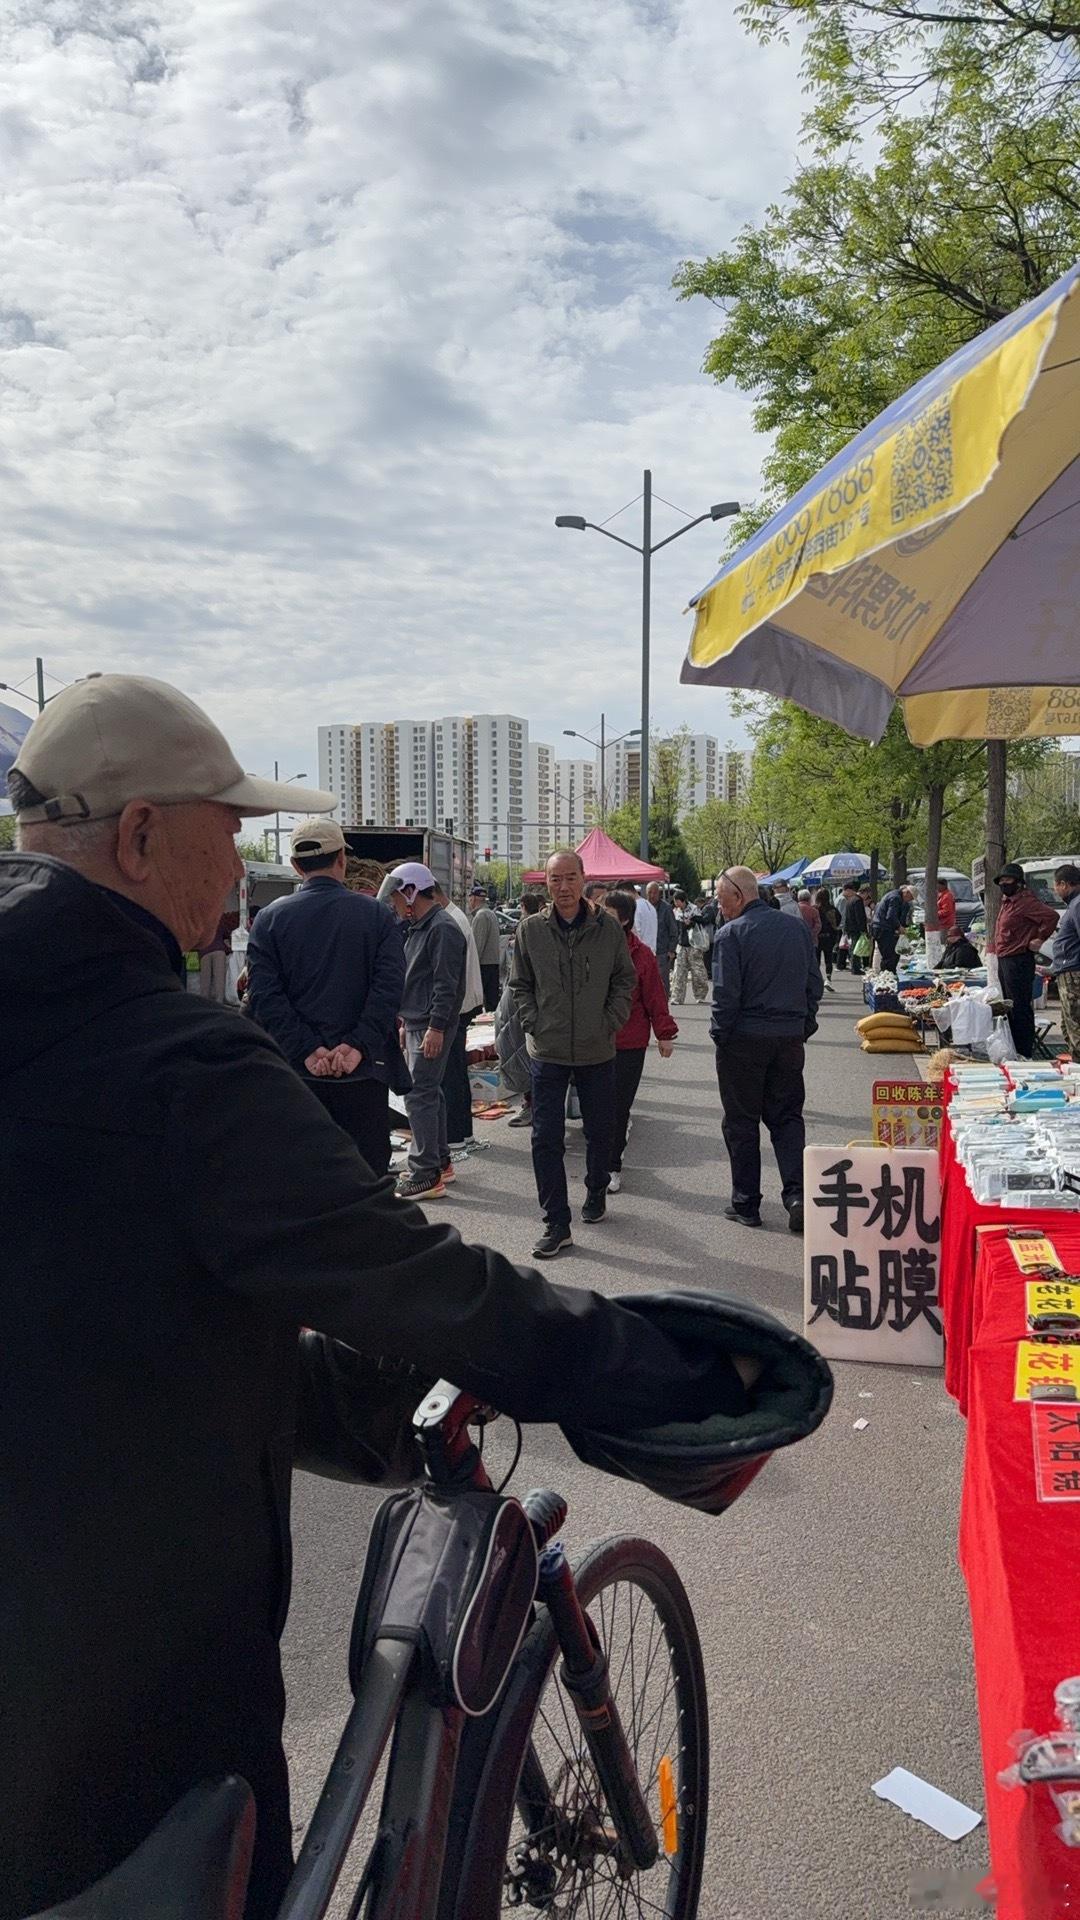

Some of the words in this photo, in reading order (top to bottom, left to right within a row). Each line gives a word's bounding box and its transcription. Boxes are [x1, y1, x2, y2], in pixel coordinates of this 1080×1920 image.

[876, 1086, 944, 1101] 回收陈年
[813, 1159, 940, 1244] 手机
[808, 1248, 942, 1335] 贴膜
